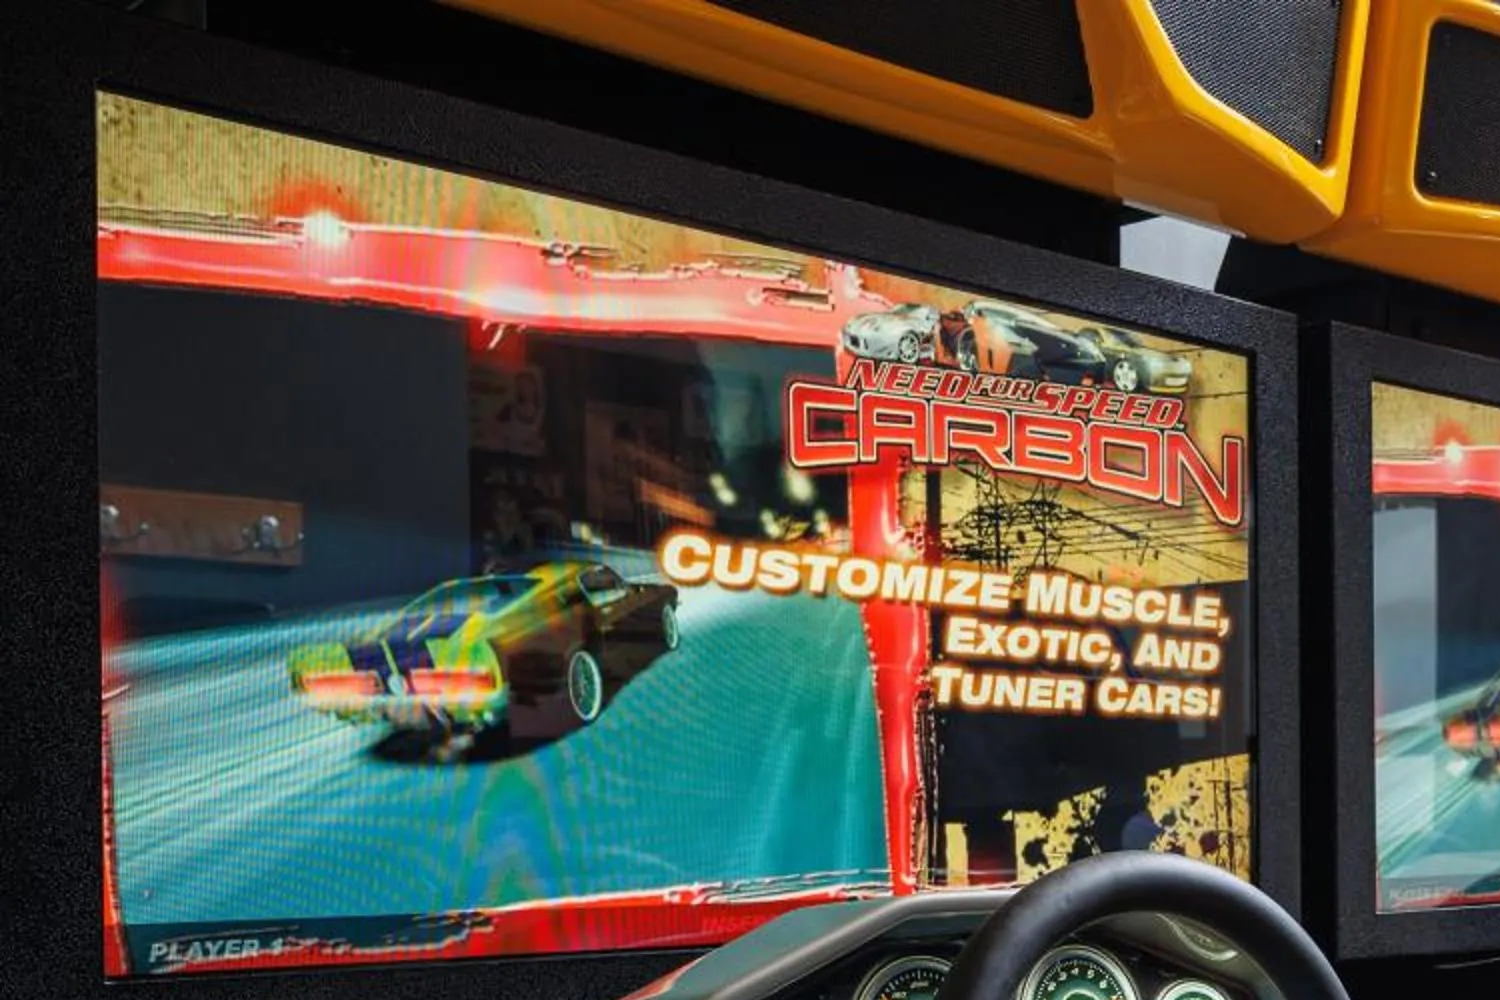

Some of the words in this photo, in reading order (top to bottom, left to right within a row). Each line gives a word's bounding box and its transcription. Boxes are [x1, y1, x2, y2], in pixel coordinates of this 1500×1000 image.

[846, 359, 971, 399] NEED
[971, 374, 1033, 400] FOR
[1031, 383, 1184, 429] SPEED
[788, 380, 1244, 528] CARBON
[661, 532, 1013, 608] CUSTOMIZE
[1026, 573, 1231, 637] MUSCLE,
[946, 616, 1124, 672] EXOTIC,
[1133, 632, 1222, 672] AND
[931, 665, 1086, 711] TUNER
[1097, 676, 1222, 718] CARS!
[148, 939, 260, 963] PLAYER
